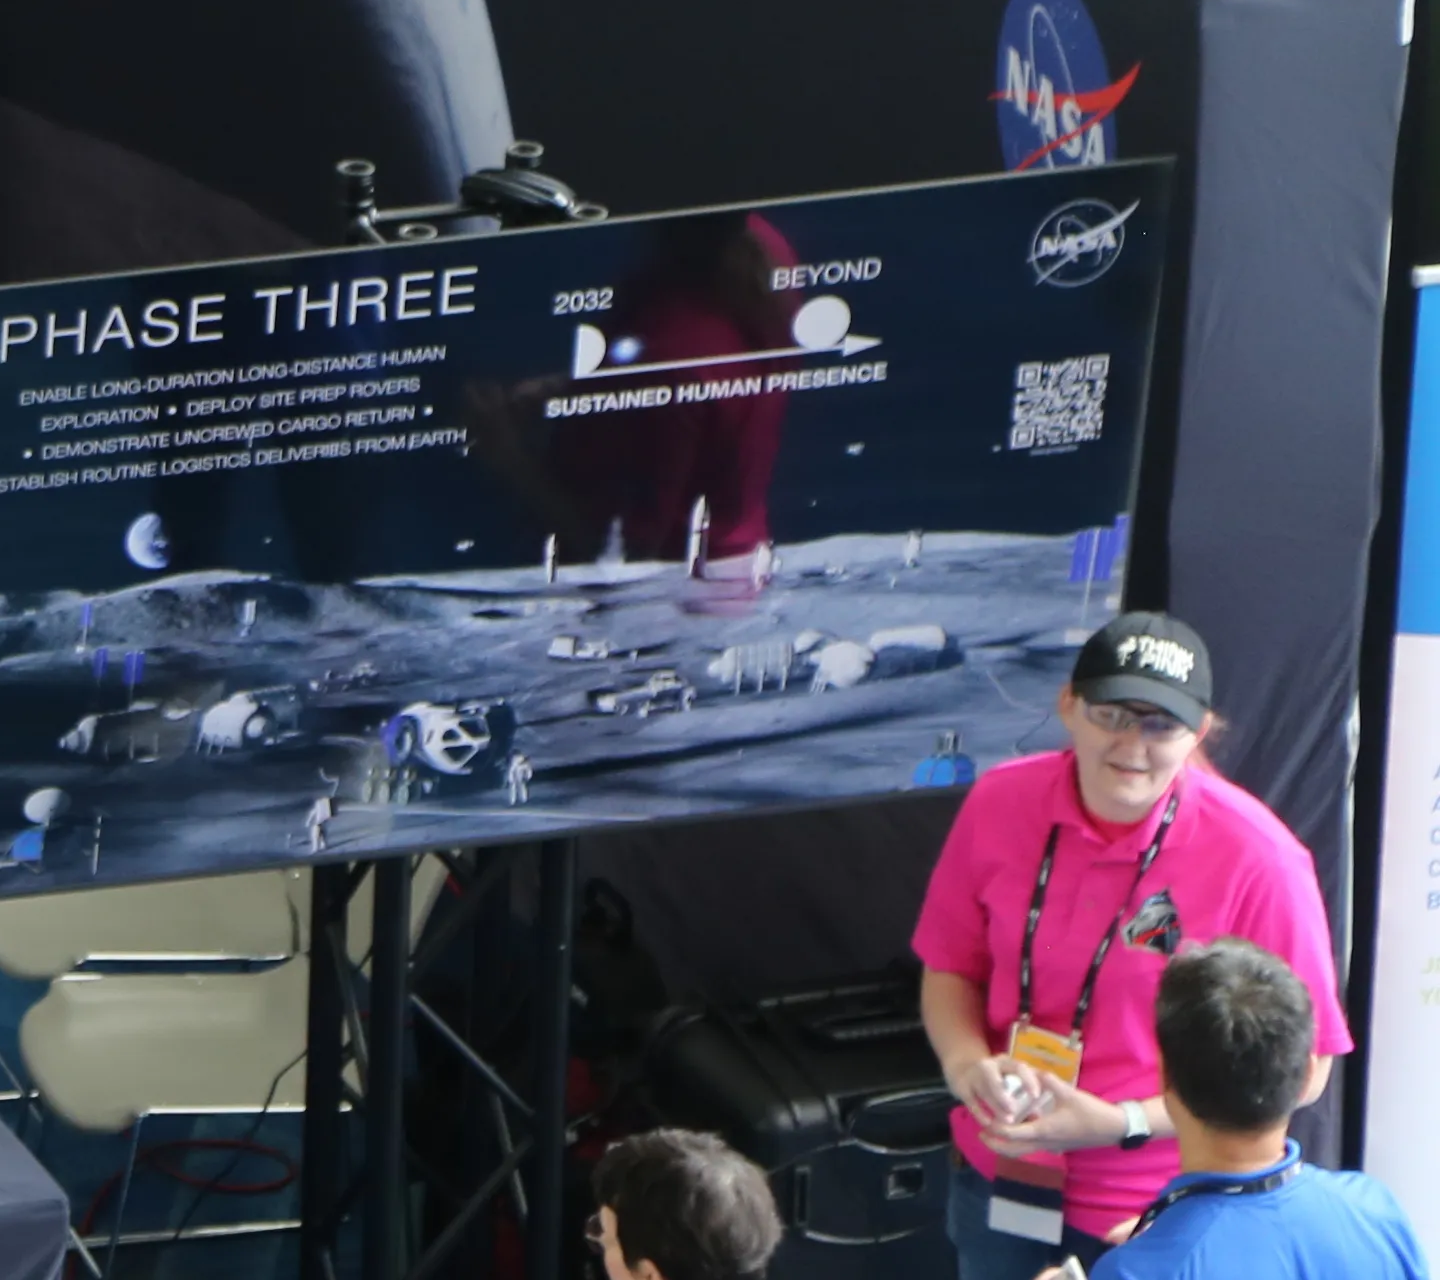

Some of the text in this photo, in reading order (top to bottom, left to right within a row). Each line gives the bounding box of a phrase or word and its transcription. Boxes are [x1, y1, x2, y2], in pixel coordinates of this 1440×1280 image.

[1005, 45, 1106, 166] NASA
[1038, 228, 1118, 260] NASA
[254, 265, 479, 336] THREE
[553, 287, 614, 315] 2032
[771, 257, 882, 291] BEYOND
[19, 345, 447, 406] ENABLE LONG-DURATION LONG-DISTANCE HUMAN
[544, 360, 888, 419] SUSTAINED HUMAN PRESENCE
[40, 377, 421, 433] EXPLORATION DEPLOY SITE PREP ROVERS
[41, 405, 415, 461] DEMONSTRATE UNCREWED CARGO RETURN
[81, 463, 157, 484] ROUTINE
[160, 453, 251, 476] LOGISTICS
[255, 441, 352, 466] DELIVERIES
[355, 433, 406, 455] FROM
[408, 427, 468, 449] EARTH
